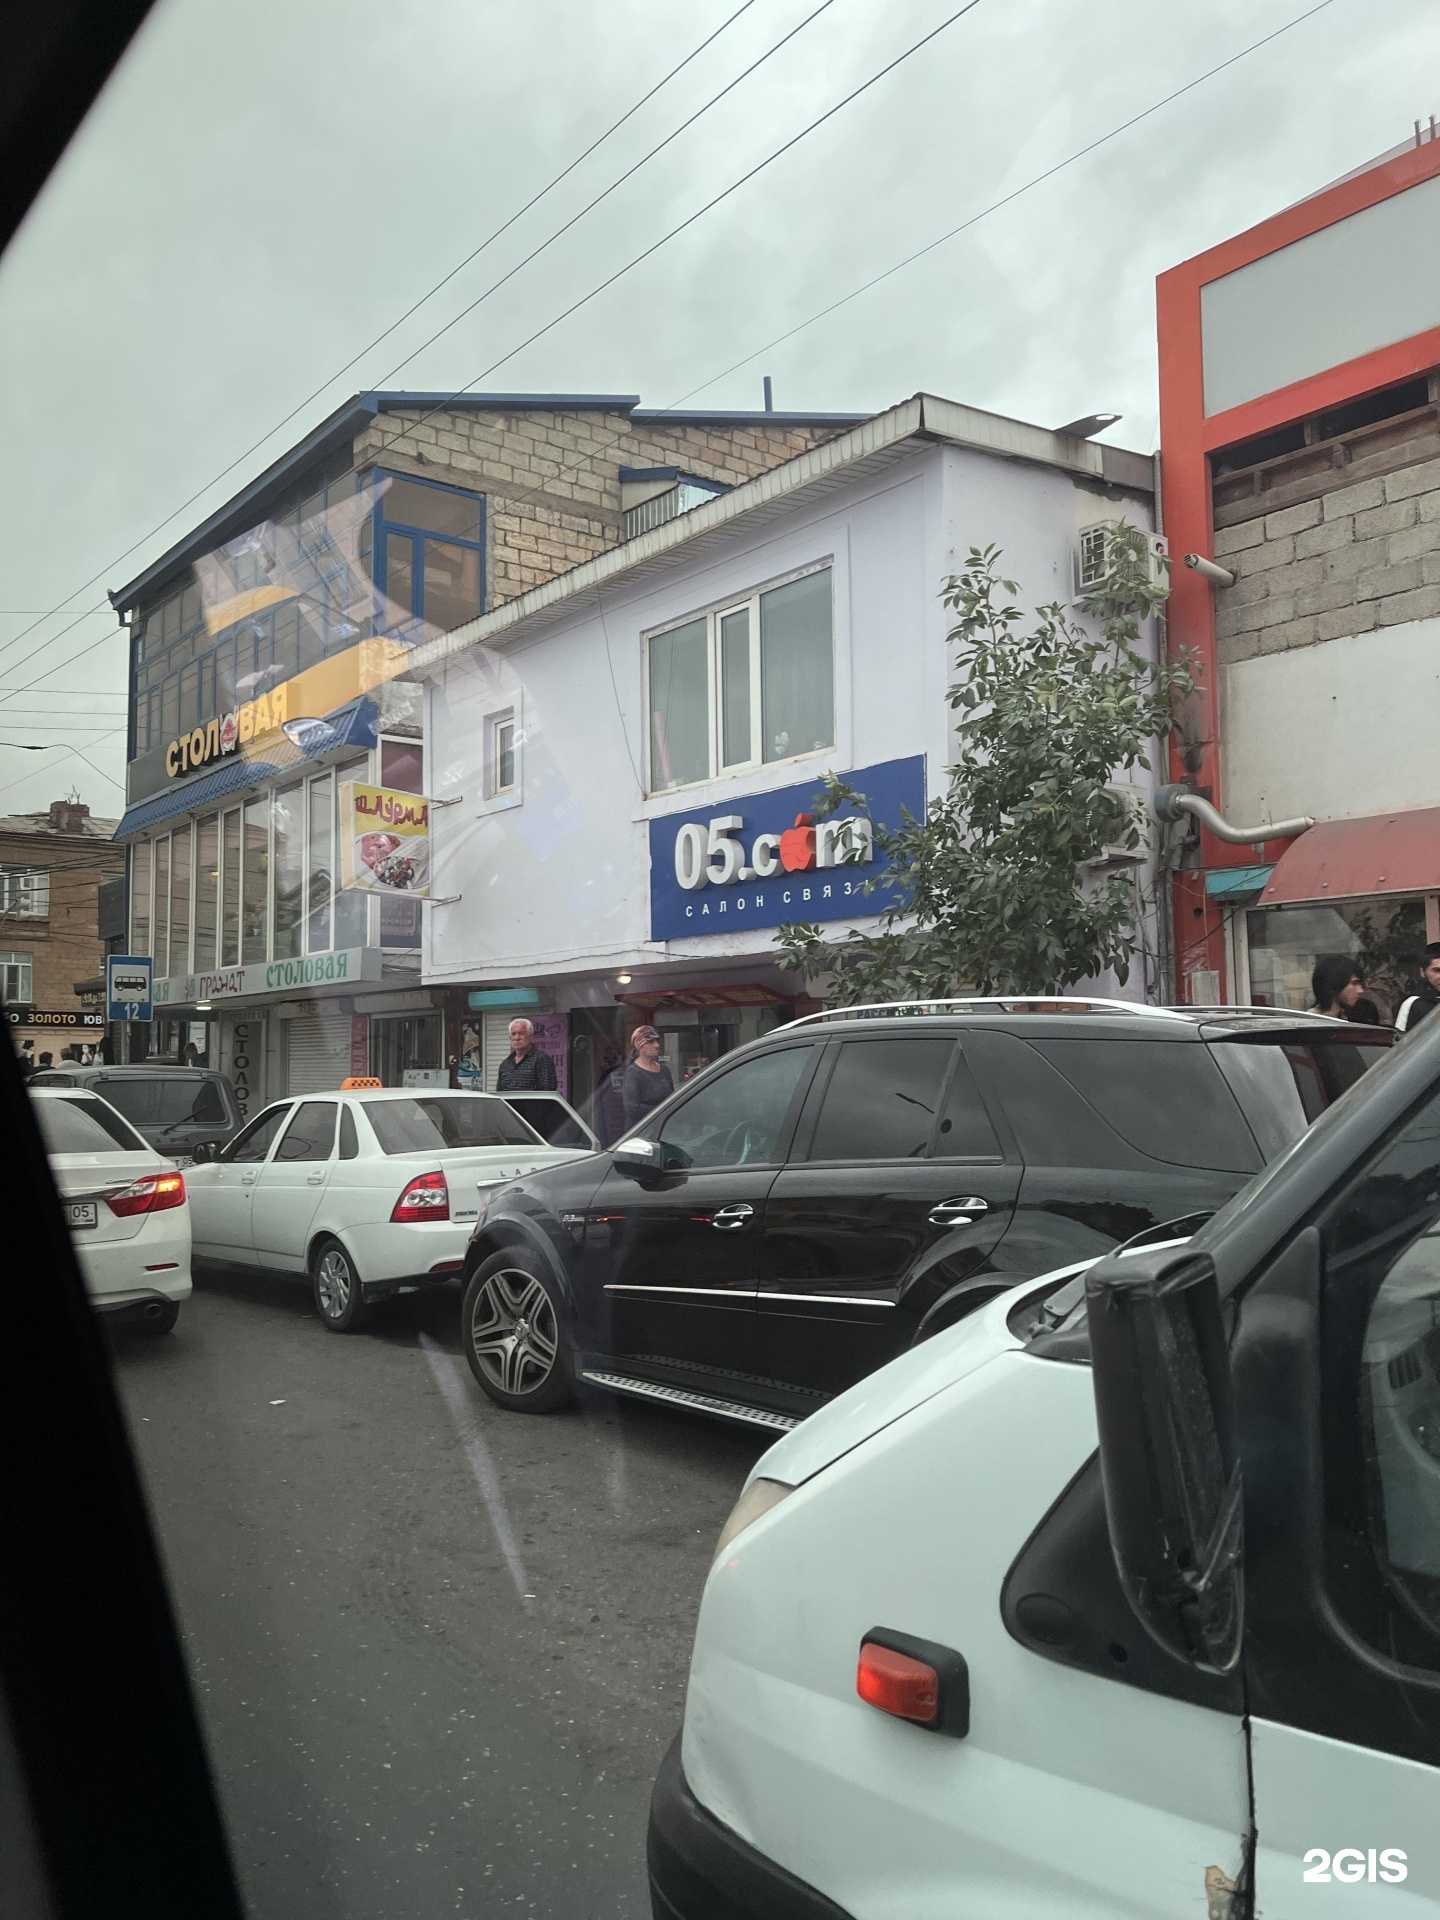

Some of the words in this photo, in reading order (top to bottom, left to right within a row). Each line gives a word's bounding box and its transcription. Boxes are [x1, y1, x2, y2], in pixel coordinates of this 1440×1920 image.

[355, 794, 428, 828] ШАУРМА
[685, 895, 764, 917] САЛОН
[27, 1013, 77, 1024] ЗОЛОТО
[83, 1014, 105, 1025] ЮВ
[124, 1002, 140, 1020] 12
[73, 1205, 90, 1218] 05
